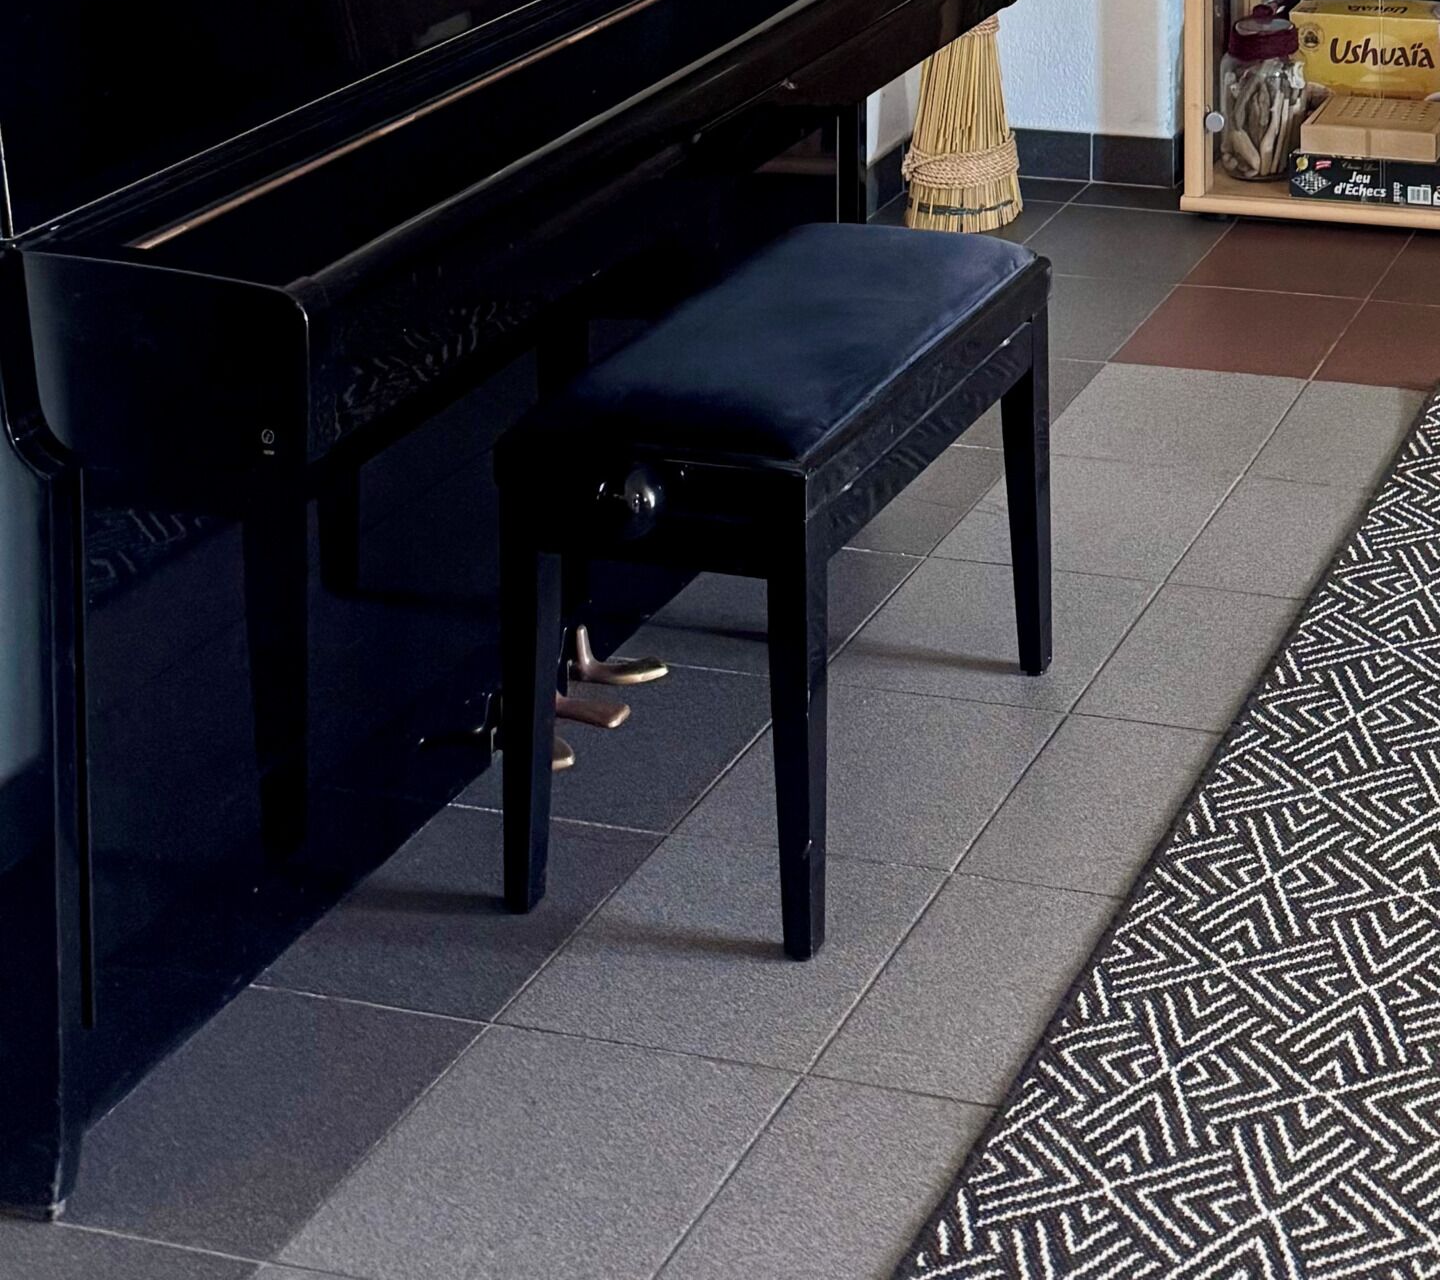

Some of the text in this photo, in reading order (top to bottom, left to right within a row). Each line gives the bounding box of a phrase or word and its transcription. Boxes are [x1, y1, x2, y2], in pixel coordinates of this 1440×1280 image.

[1330, 37, 1435, 69] Ushuaïa
[1349, 171, 1371, 183] Jeu
[1334, 182, 1387, 198] d'Echecs
